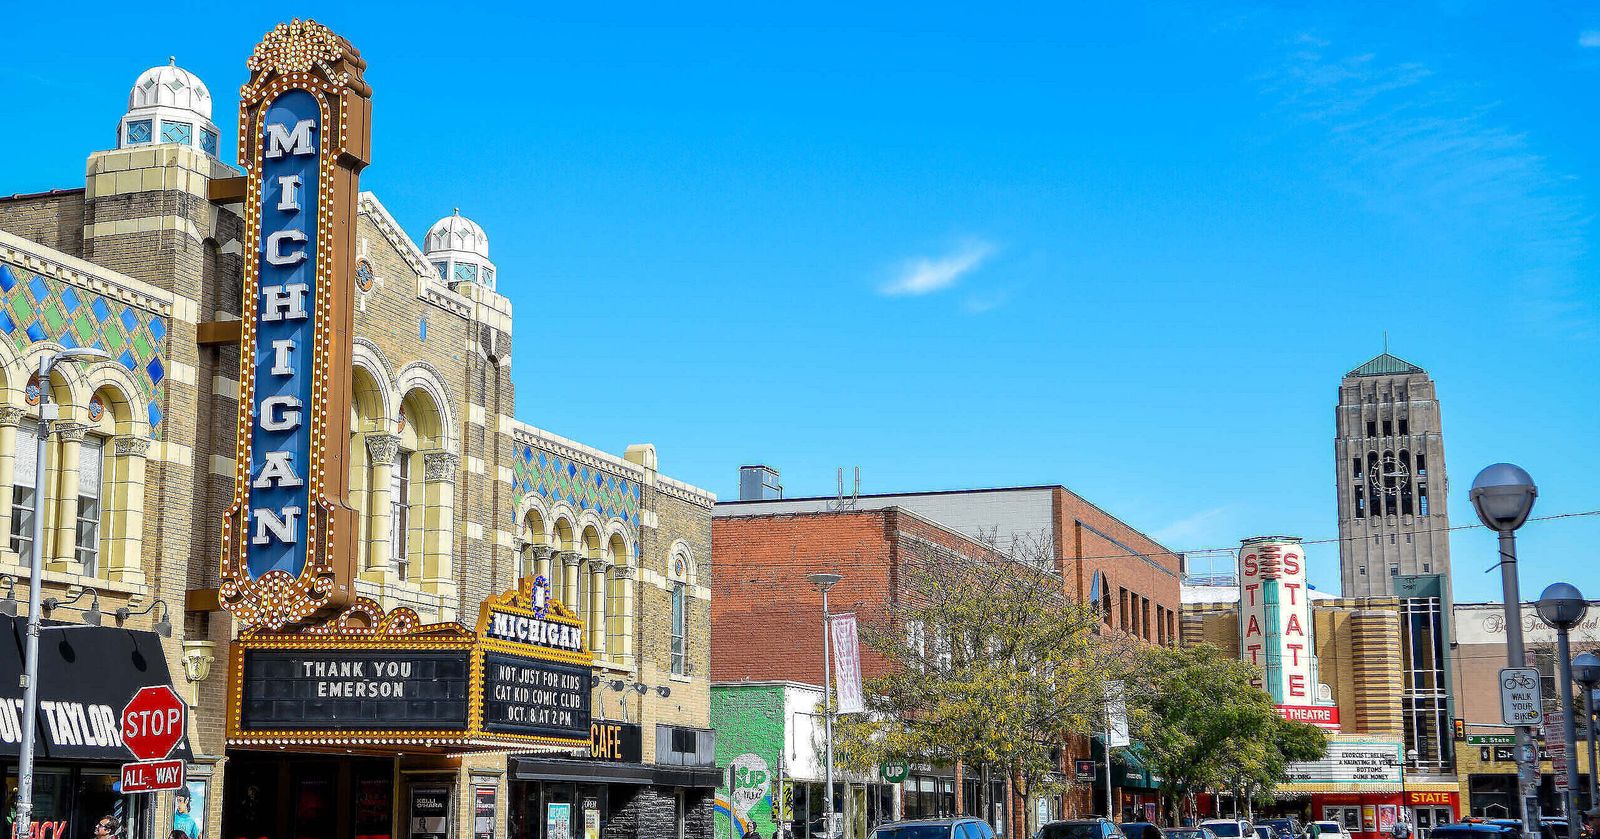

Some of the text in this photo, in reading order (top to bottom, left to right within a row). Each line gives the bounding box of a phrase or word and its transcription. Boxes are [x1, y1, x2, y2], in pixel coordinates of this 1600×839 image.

[252, 118, 317, 545] MICHIGAN
[493, 611, 582, 650] MICHIGAN
[1283, 553, 1305, 697] STATE
[303, 661, 412, 677] THANK YOU
[499, 665, 580, 691] NOT JUST FOR KIDS
[318, 681, 404, 697] EMERSON
[495, 684, 580, 709] CAT KID COMIC CLUB
[508, 706, 527, 722] OCT.
[539, 708, 549, 724] AT
[552, 710, 557, 725] 2
[560, 711, 571, 726] PM
[1289, 710, 1331, 720] THEATRE
[1511, 702, 1533, 710] YOUR
[1514, 712, 1532, 720] BIKE
[41, 701, 122, 748] TAYLOR
[125, 708, 180, 738] STOP
[590, 723, 622, 758] CAFE
[124, 766, 180, 787] ALL WAY
[885, 766, 904, 778] UP
[1411, 793, 1449, 803] STATE
